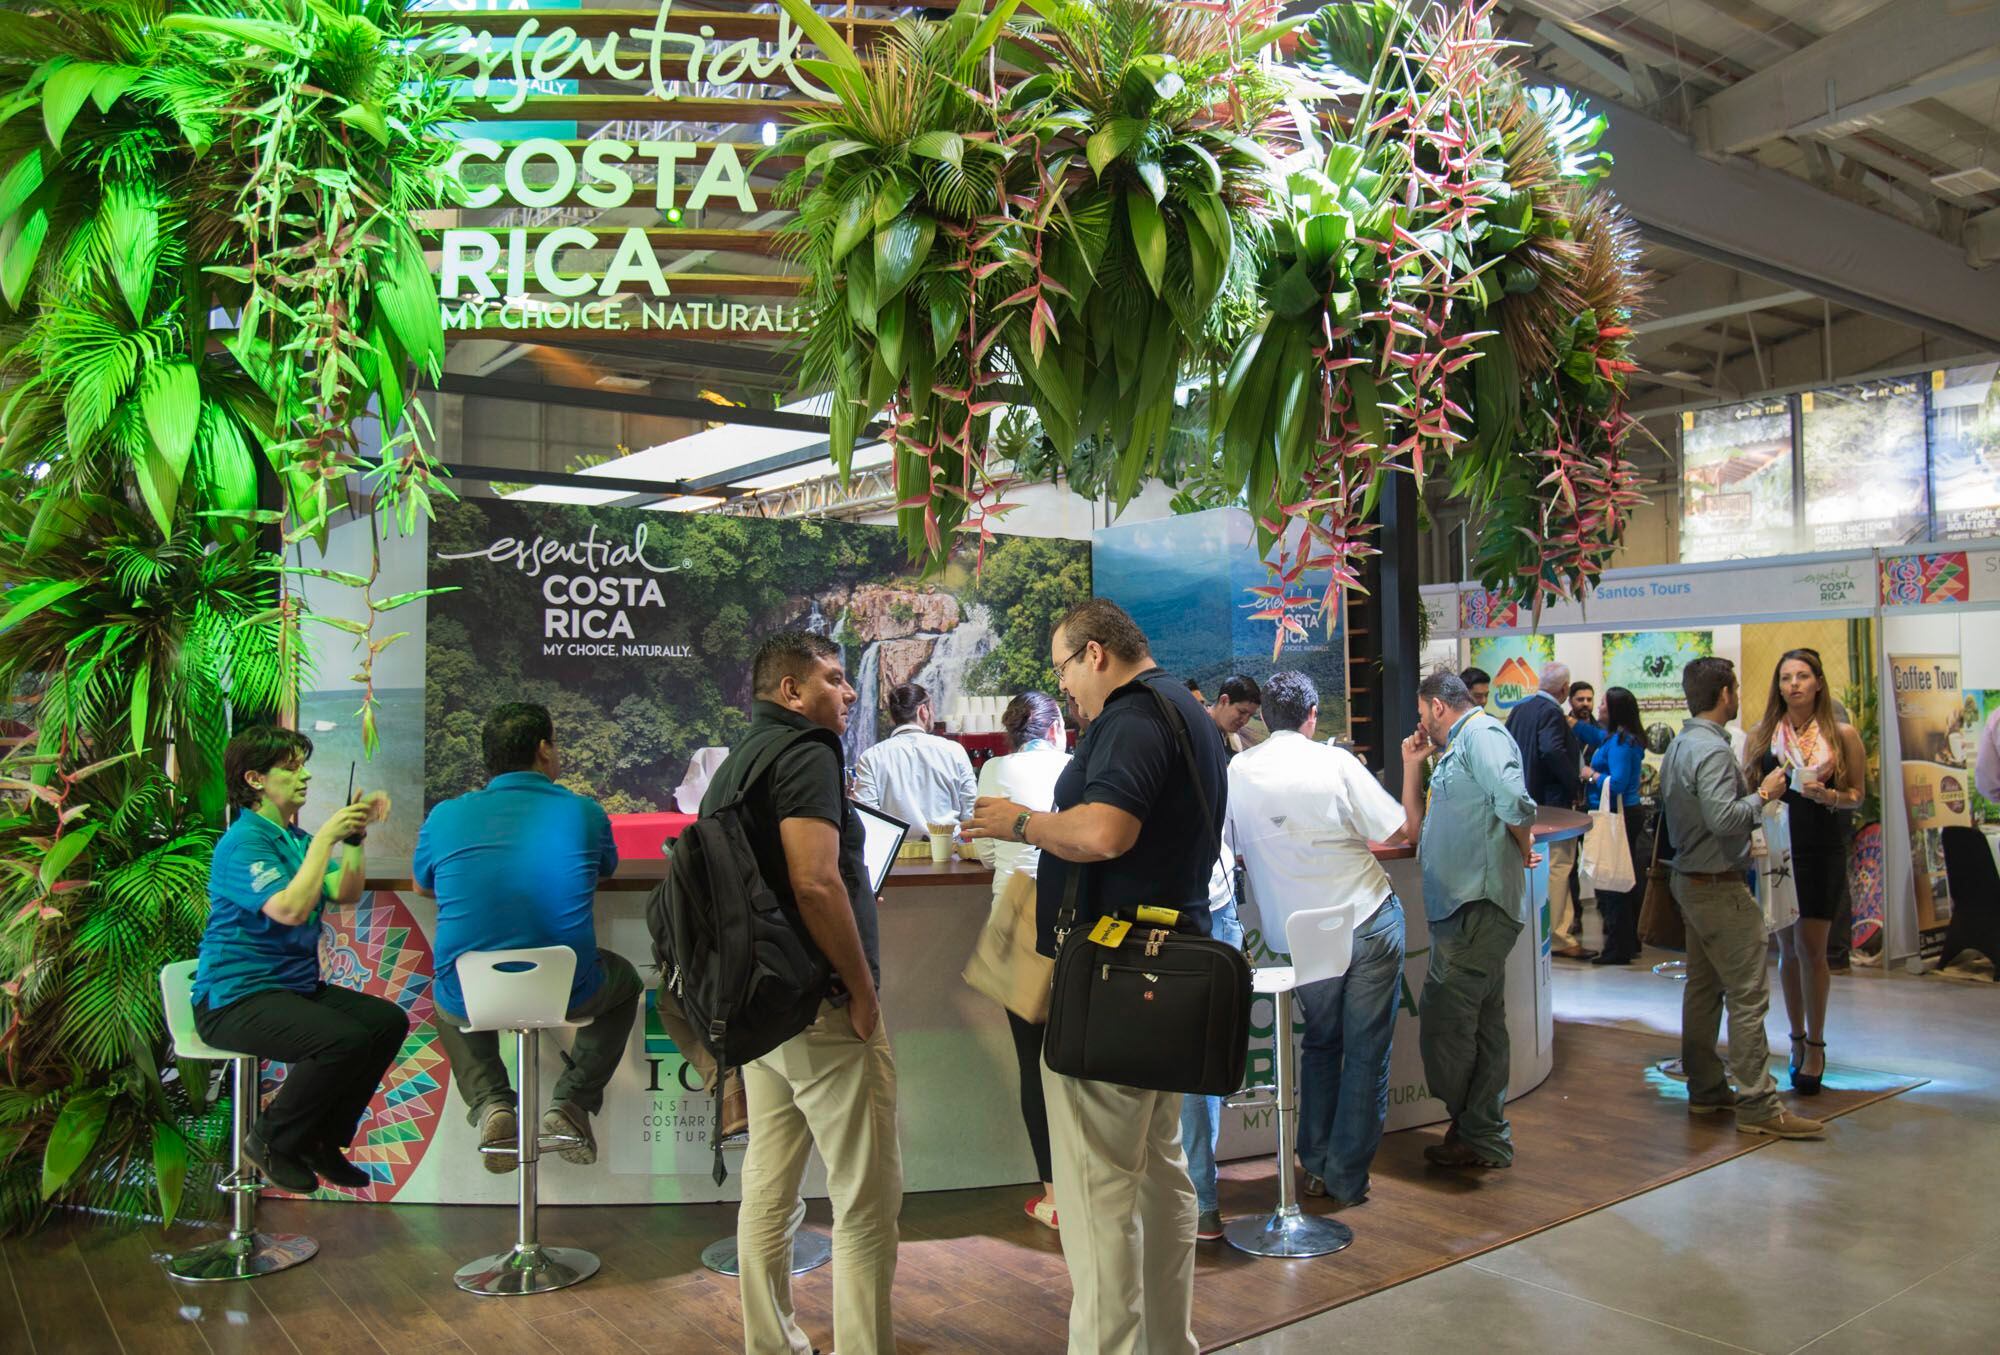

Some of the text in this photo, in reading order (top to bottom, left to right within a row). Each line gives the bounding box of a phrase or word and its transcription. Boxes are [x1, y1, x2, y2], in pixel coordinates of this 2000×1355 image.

[444, 137, 758, 213] COSTA
[440, 227, 671, 300] RICA
[441, 302, 489, 331] MY
[499, 301, 630, 332] CHOICE,
[436, 522, 681, 577] essential
[542, 574, 666, 608] COSTA
[1596, 582, 1691, 600] Santos Tours
[1819, 581, 1855, 592] COSTA
[1819, 591, 1847, 601] RICA
[544, 608, 636, 640] RICA
[1279, 629, 1309, 644] ICA
[543, 643, 692, 658] MY CHOICE, NATURALLY.
[1627, 680, 1682, 690] extremefore
[1893, 665, 1958, 691] Coffee Tour
[642, 1115, 717, 1127] COSTARRC
[1243, 1108, 1274, 1131] MY
[642, 1130, 662, 1142] DE
